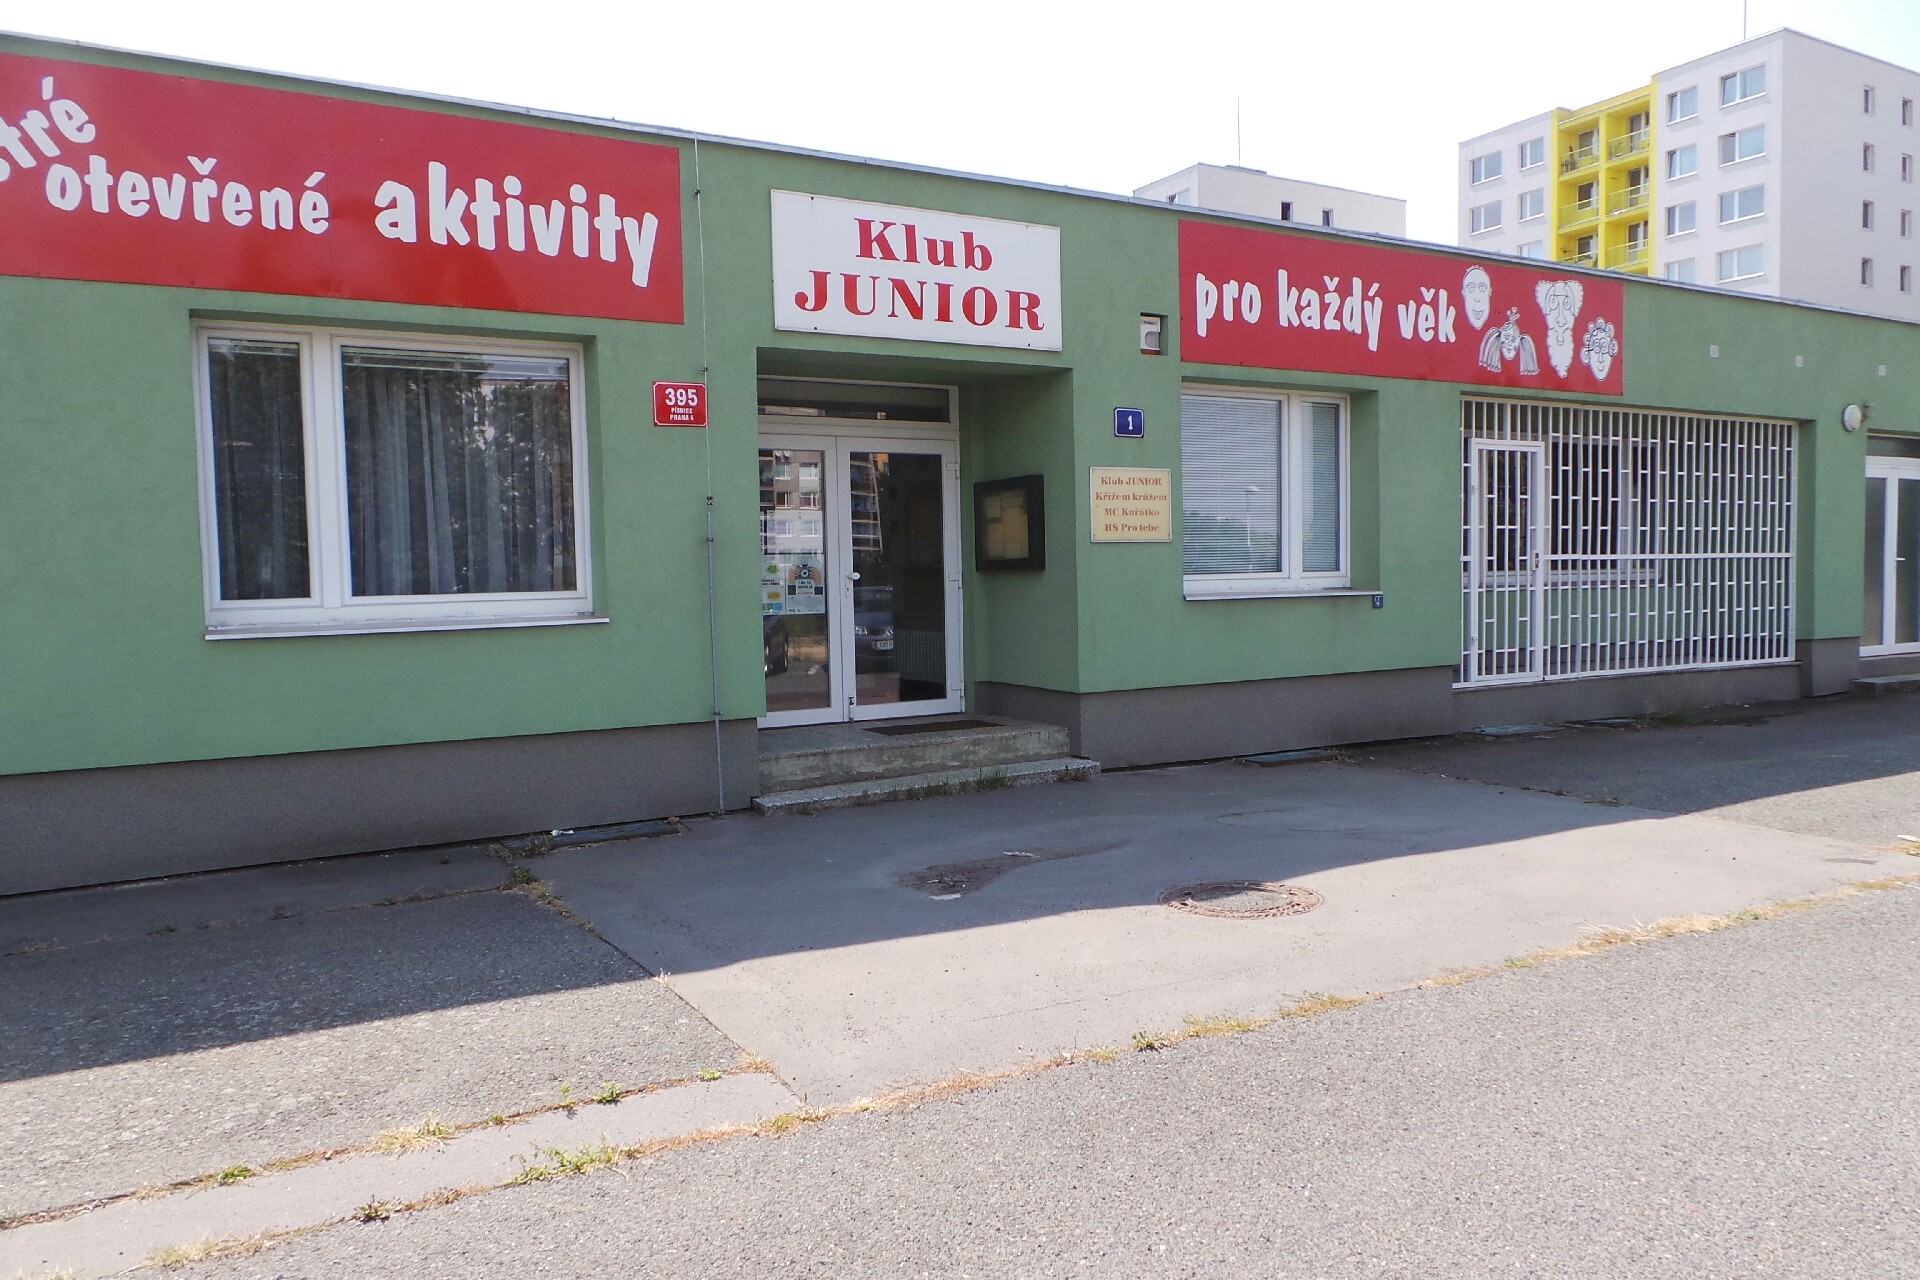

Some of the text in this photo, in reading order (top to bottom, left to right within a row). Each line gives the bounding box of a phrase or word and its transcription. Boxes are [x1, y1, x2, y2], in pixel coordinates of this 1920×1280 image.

[0, 76, 96, 182] tré
[46, 154, 659, 288] otevřené aktivity
[854, 217, 993, 272] Klub
[794, 270, 1045, 331] JUNIOR
[1195, 268, 1456, 352] pro každý věk
[665, 387, 698, 406] 395
[671, 406, 692, 414] PÍSNICE
[1127, 414, 1133, 431] 1
[1100, 476, 1162, 486] Klub JUNIOR
[1095, 492, 1168, 501] Křížem krážem
[1104, 507, 1160, 516] MC Kuřátko
[1104, 523, 1159, 532] HS Pro tebe
